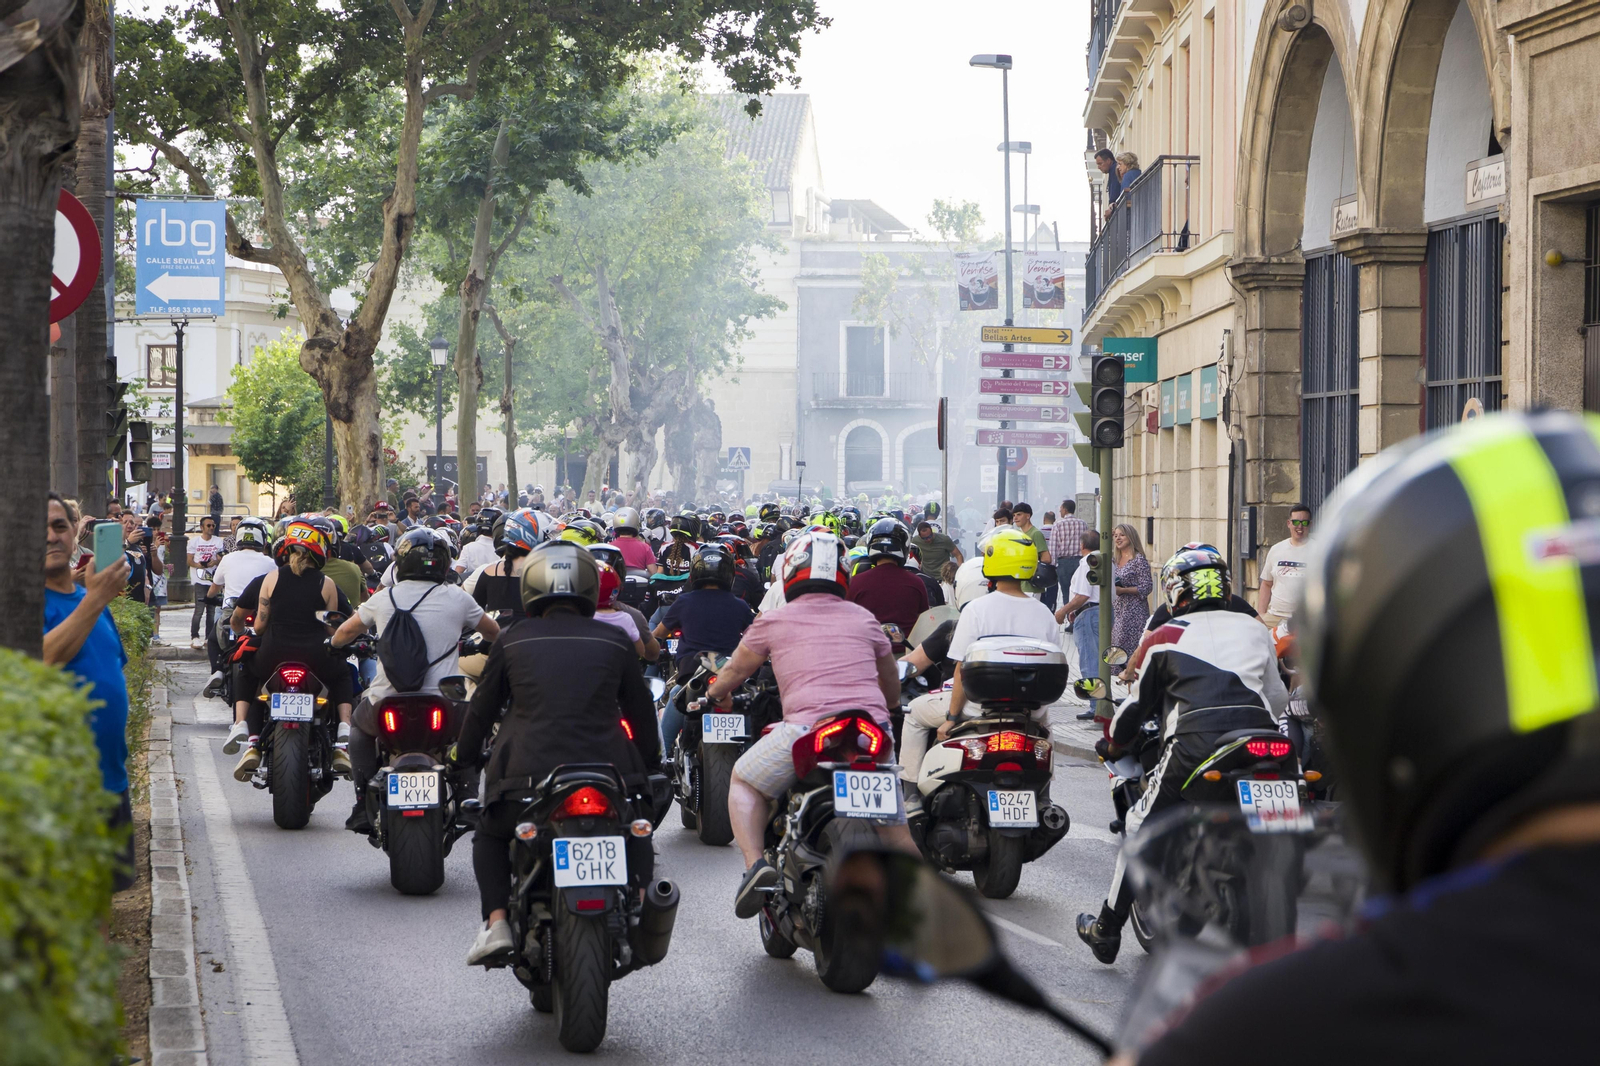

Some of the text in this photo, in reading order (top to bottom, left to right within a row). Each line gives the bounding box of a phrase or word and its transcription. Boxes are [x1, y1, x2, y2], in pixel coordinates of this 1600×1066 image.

[145, 208, 216, 256] rbg
[146, 257, 171, 265] CALLE
[173, 257, 205, 265] SEVILLA
[1027, 264, 1061, 275] Venirse
[984, 333, 1032, 342] Bellas Artes
[291, 528, 313, 539] 37
[551, 562, 571, 570] GIVI
[281, 695, 311, 706] 2239
[285, 705, 307, 717] LJL
[712, 716, 742, 728] 0897
[400, 775, 436, 788] 6010
[850, 775, 893, 792] 0023
[405, 789, 431, 803] KYK
[1252, 783, 1295, 799] 3909
[850, 792, 883, 808] LVW
[998, 793, 1031, 806] 6247
[1003, 807, 1030, 820] HDF
[1254, 799, 1287, 816] FJJ
[572, 841, 617, 861] 6218
[558, 857, 566, 866] E
[576, 861, 616, 881] GHK
